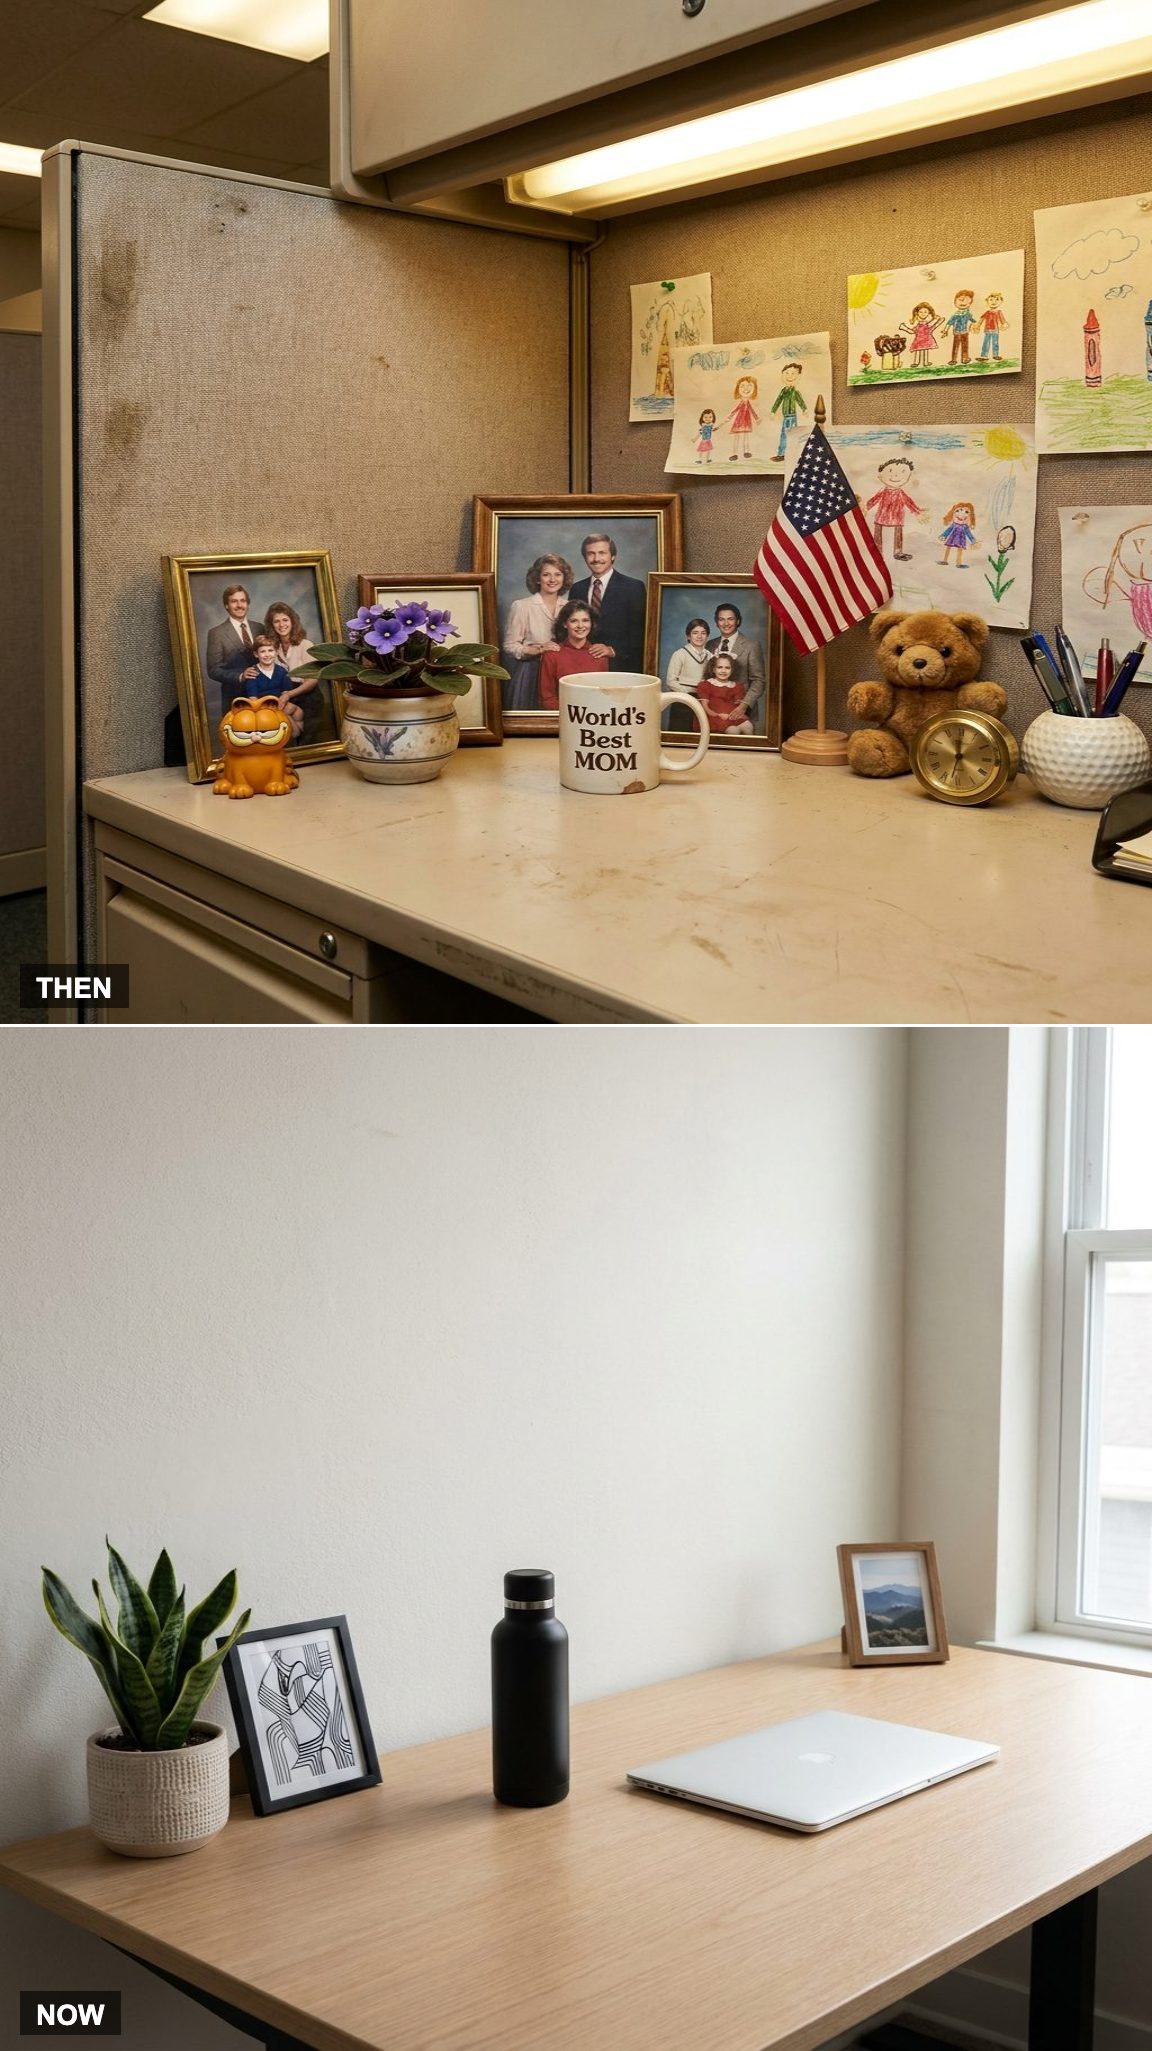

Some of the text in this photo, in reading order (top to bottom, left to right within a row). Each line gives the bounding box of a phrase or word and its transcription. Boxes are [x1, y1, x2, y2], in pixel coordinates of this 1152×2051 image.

[567, 704, 646, 726] World's
[580, 729, 632, 748] Best
[574, 750, 638, 771] MOM
